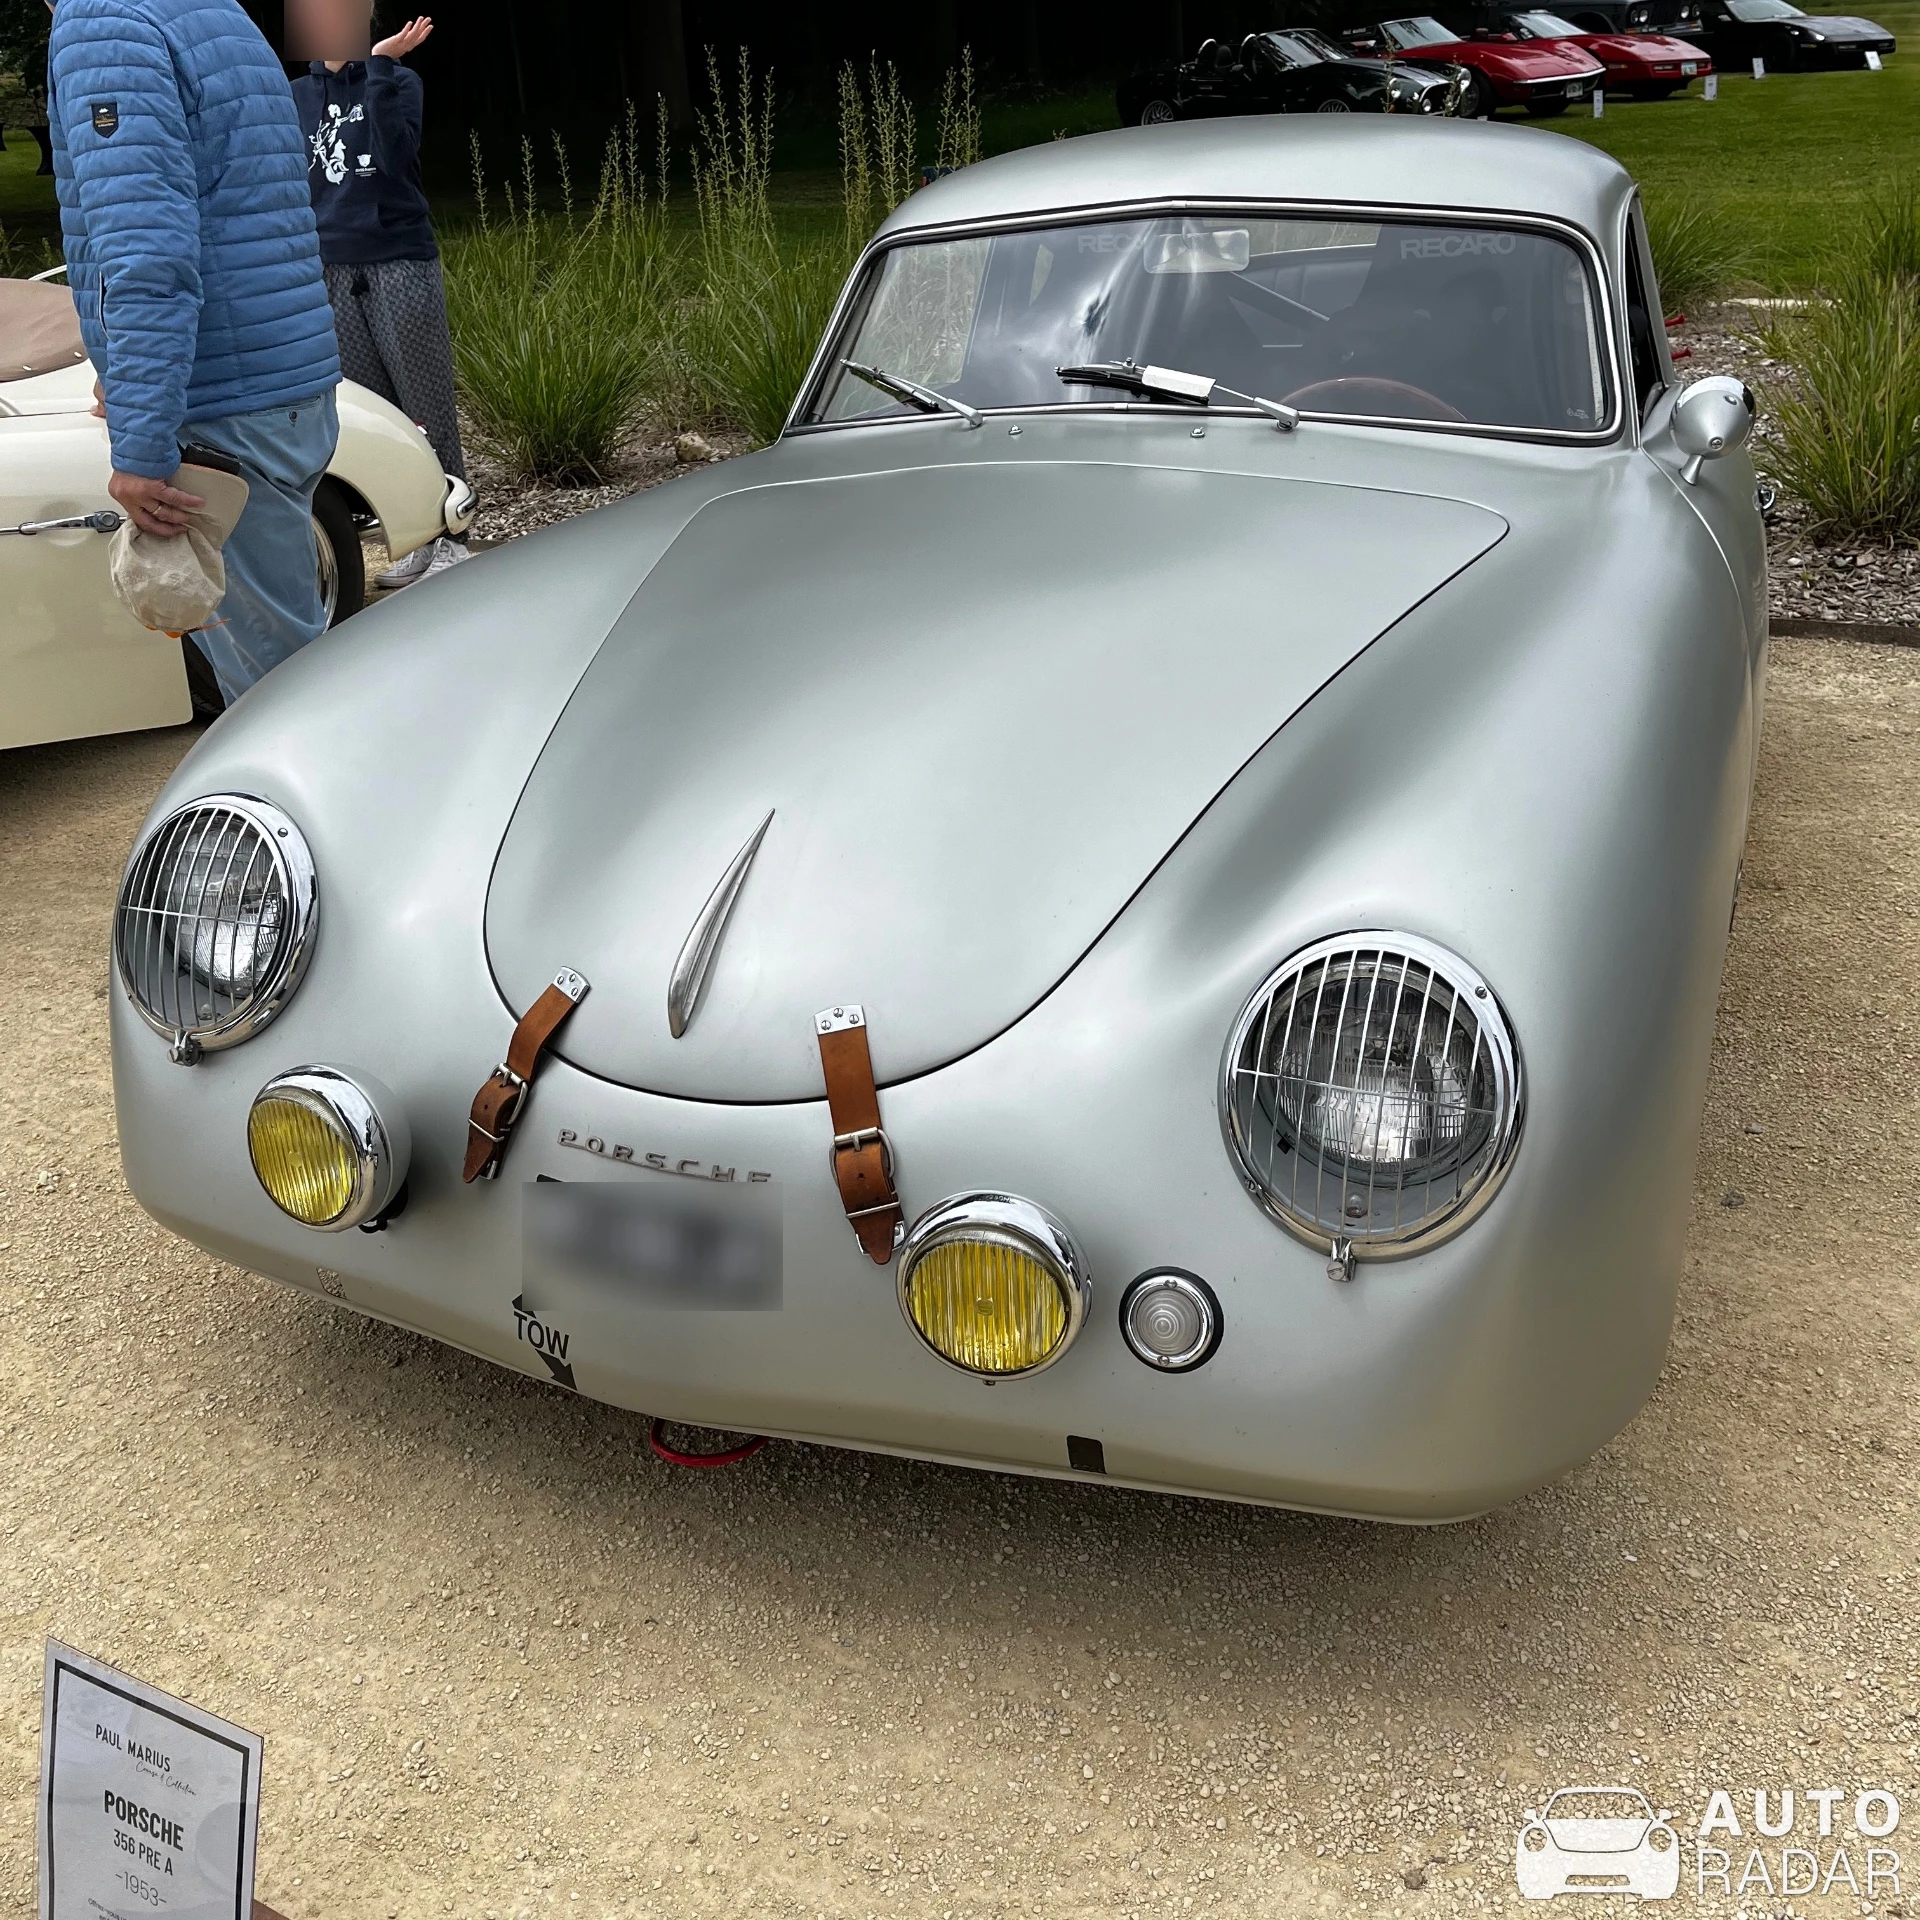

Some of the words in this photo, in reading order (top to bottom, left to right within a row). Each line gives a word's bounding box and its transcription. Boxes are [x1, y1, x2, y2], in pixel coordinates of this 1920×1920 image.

[1400, 233, 1517, 260] RECARO
[513, 1310, 570, 1360] TOW
[95, 1723, 122, 1751] PAUL
[127, 1739, 171, 1773] MARIUS
[104, 1789, 184, 1852] PORSCHE
[113, 1828, 135, 1855] 356
[139, 1841, 161, 1871] PRE
[164, 1856, 173, 1876] A
[115, 1871, 167, 1907] -1953-
